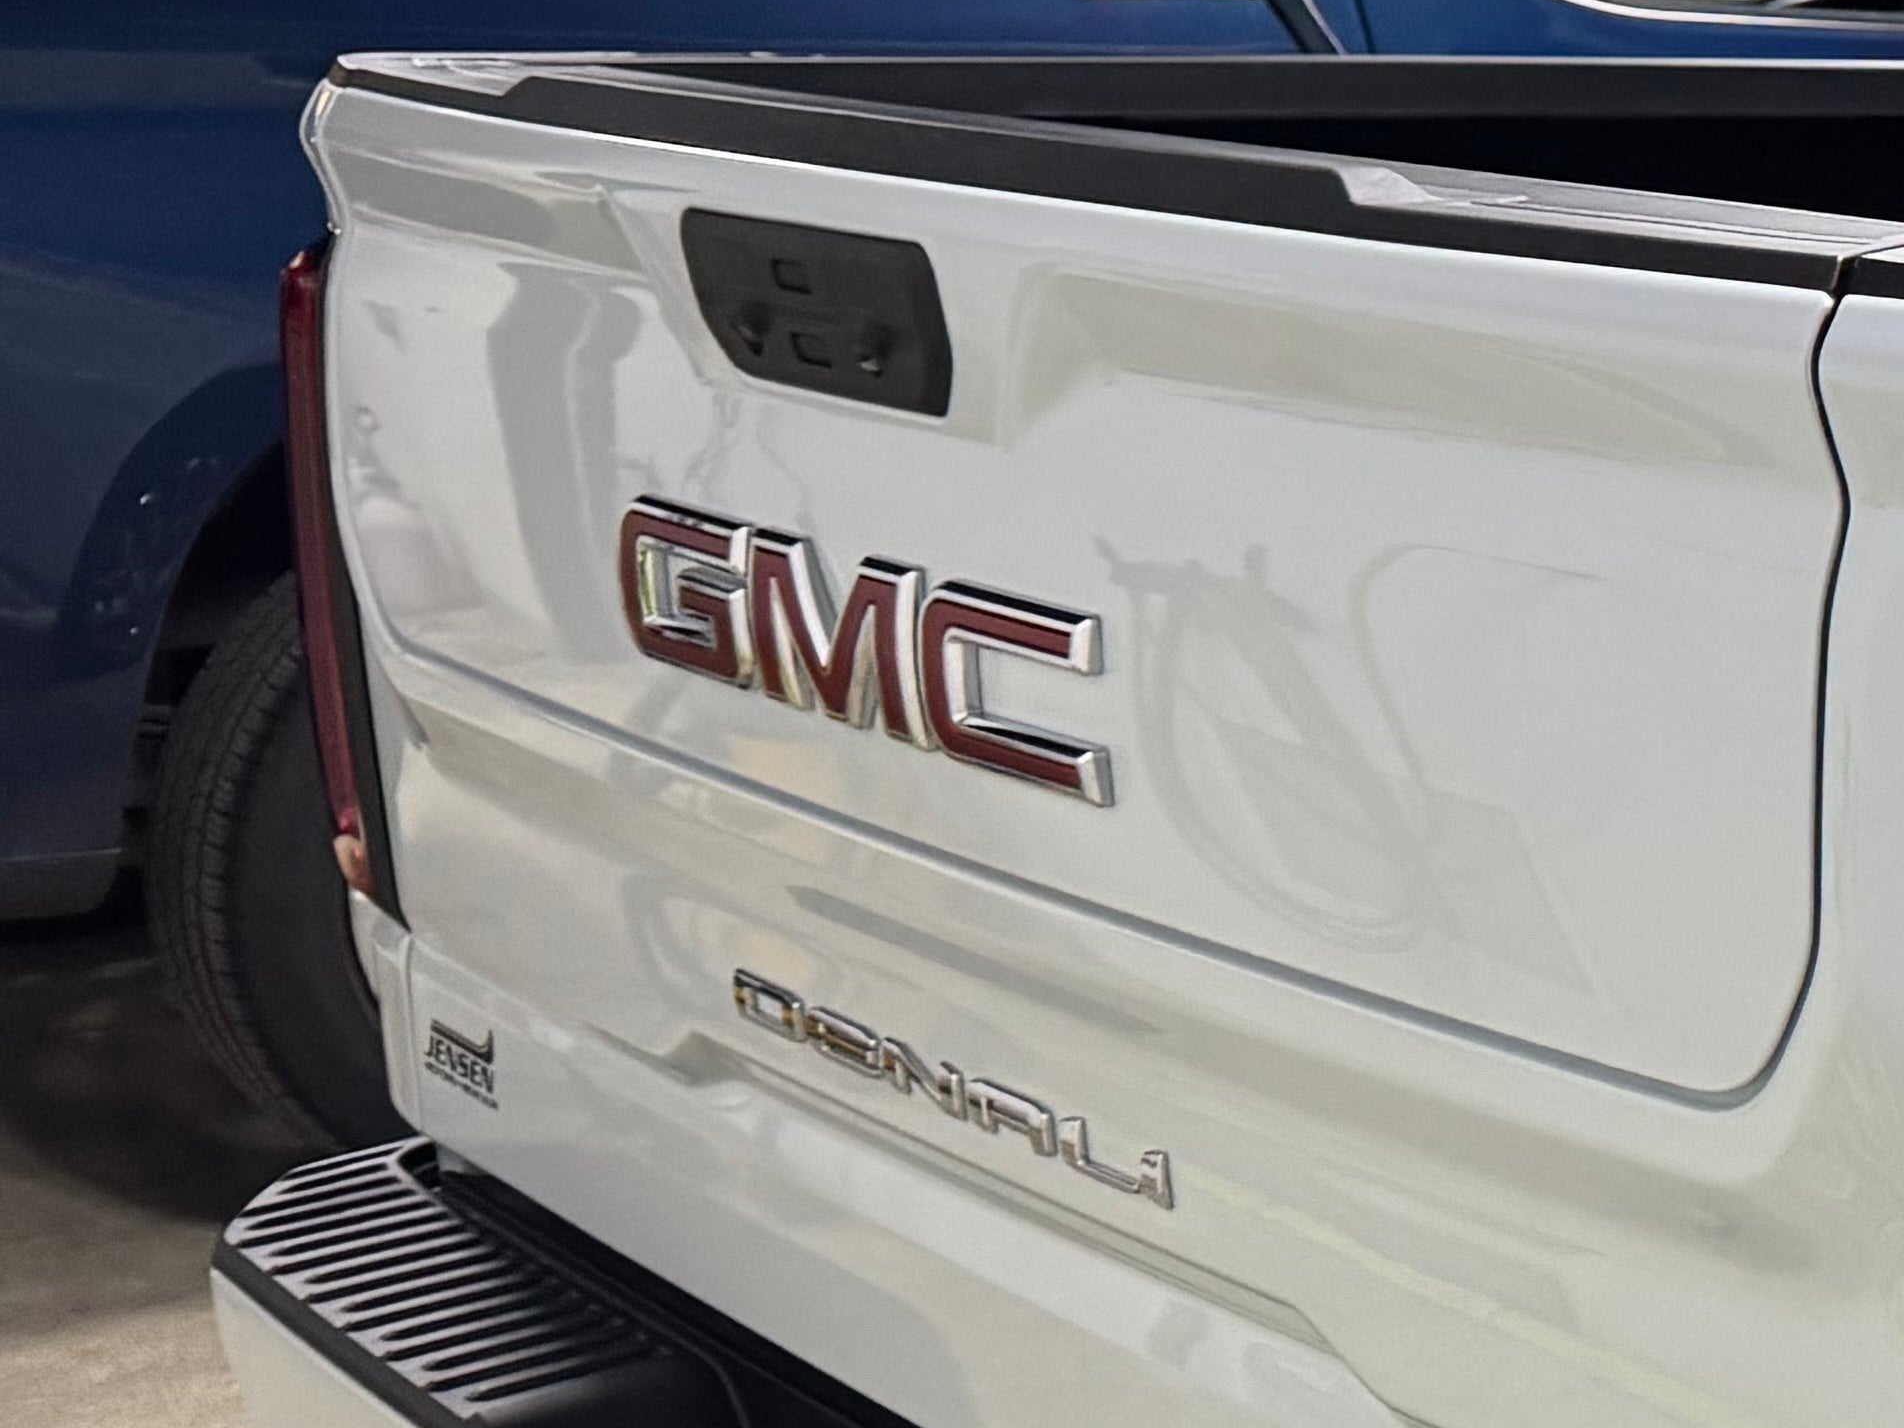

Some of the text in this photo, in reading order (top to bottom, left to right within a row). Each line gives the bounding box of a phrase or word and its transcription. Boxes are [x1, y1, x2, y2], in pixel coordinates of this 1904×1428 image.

[619, 494, 1115, 807] GMC
[424, 1035, 494, 1094] JENSEN
[733, 969, 1174, 1210] DENALI
